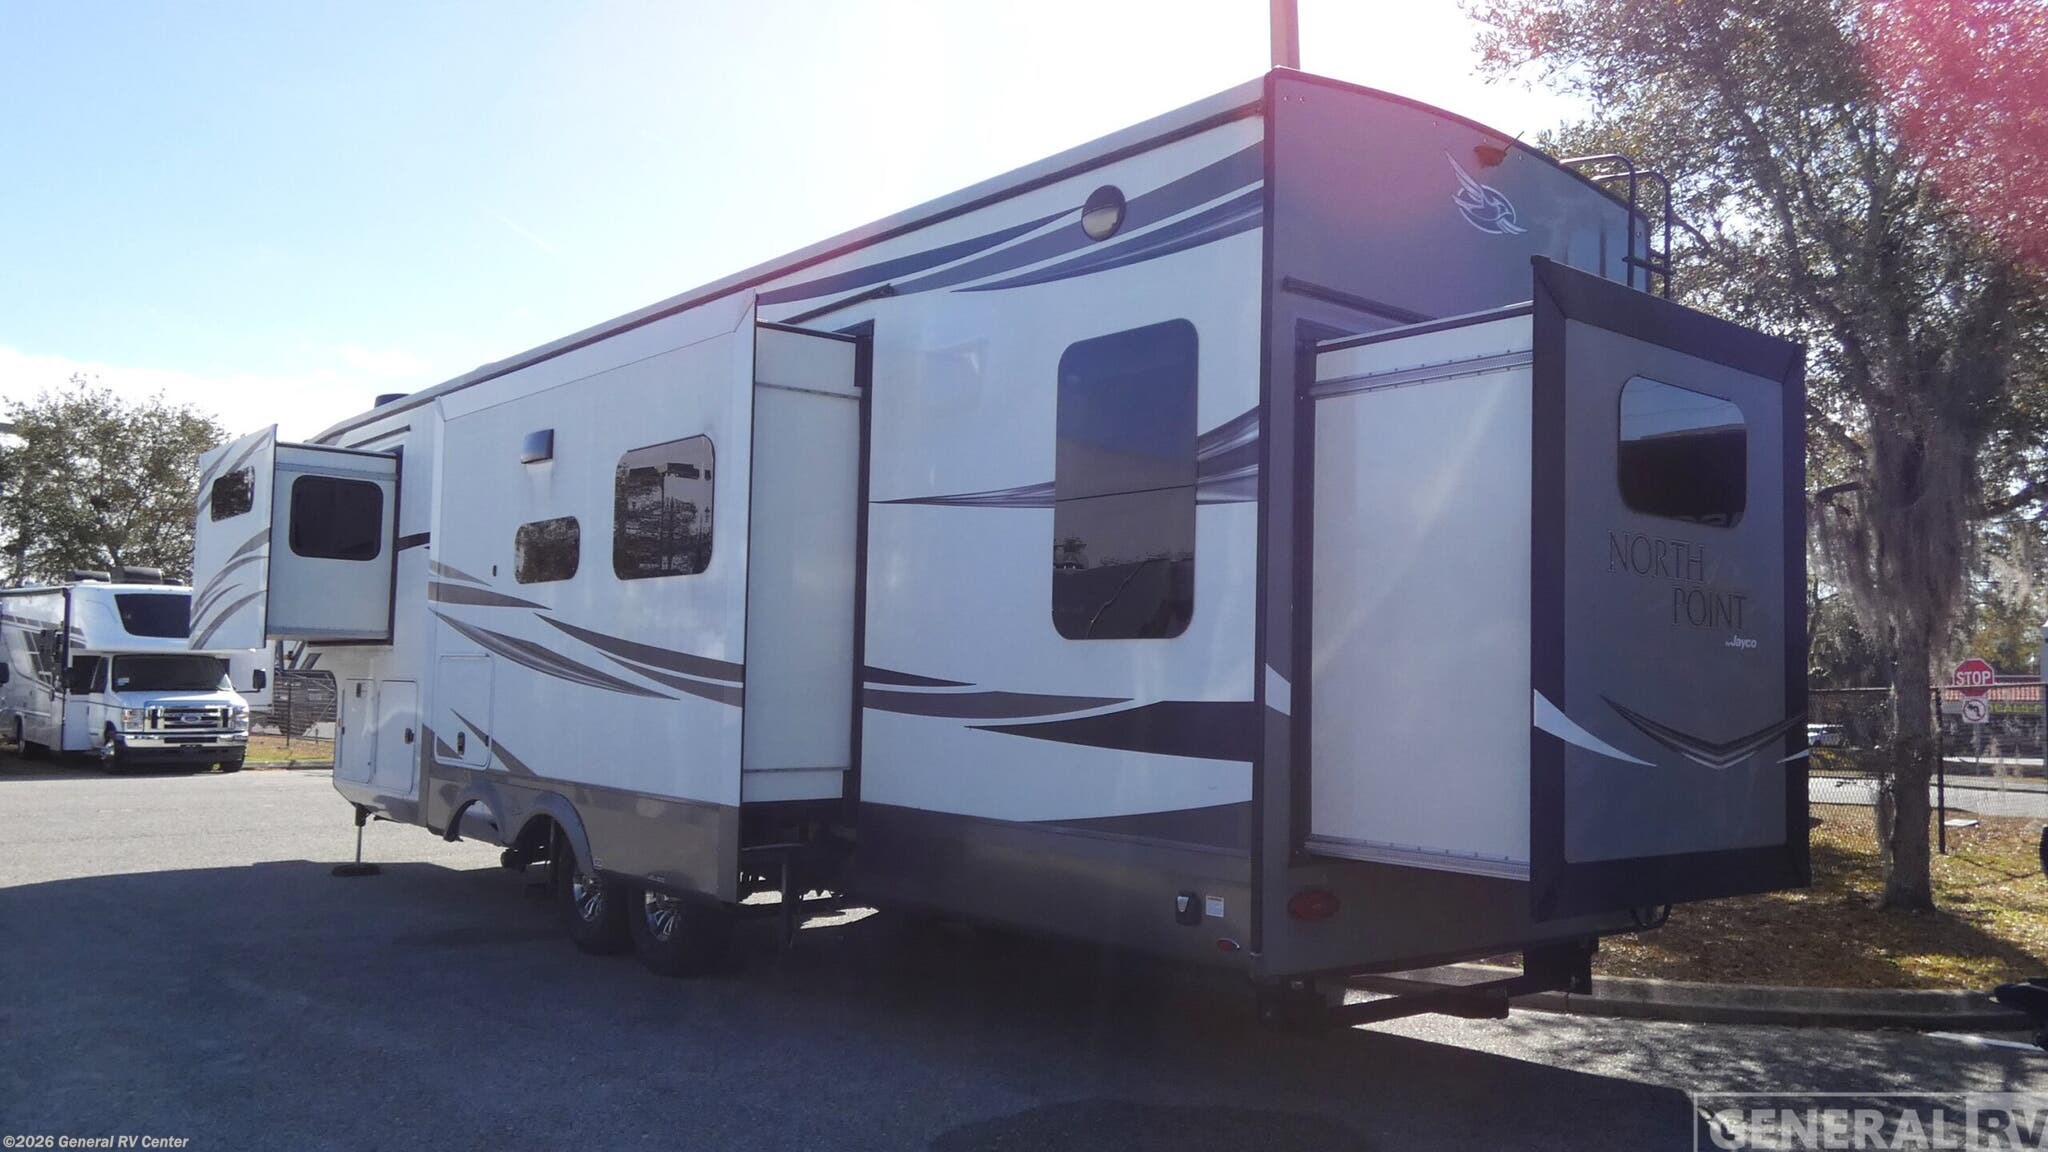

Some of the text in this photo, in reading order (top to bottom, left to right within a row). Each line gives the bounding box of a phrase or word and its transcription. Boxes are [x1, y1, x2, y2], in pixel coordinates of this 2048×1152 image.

[1608, 529, 1705, 583] NORTH
[1671, 586, 1748, 630] POINT
[1732, 634, 1757, 649] Jayco
[1956, 671, 1991, 686] STOP
